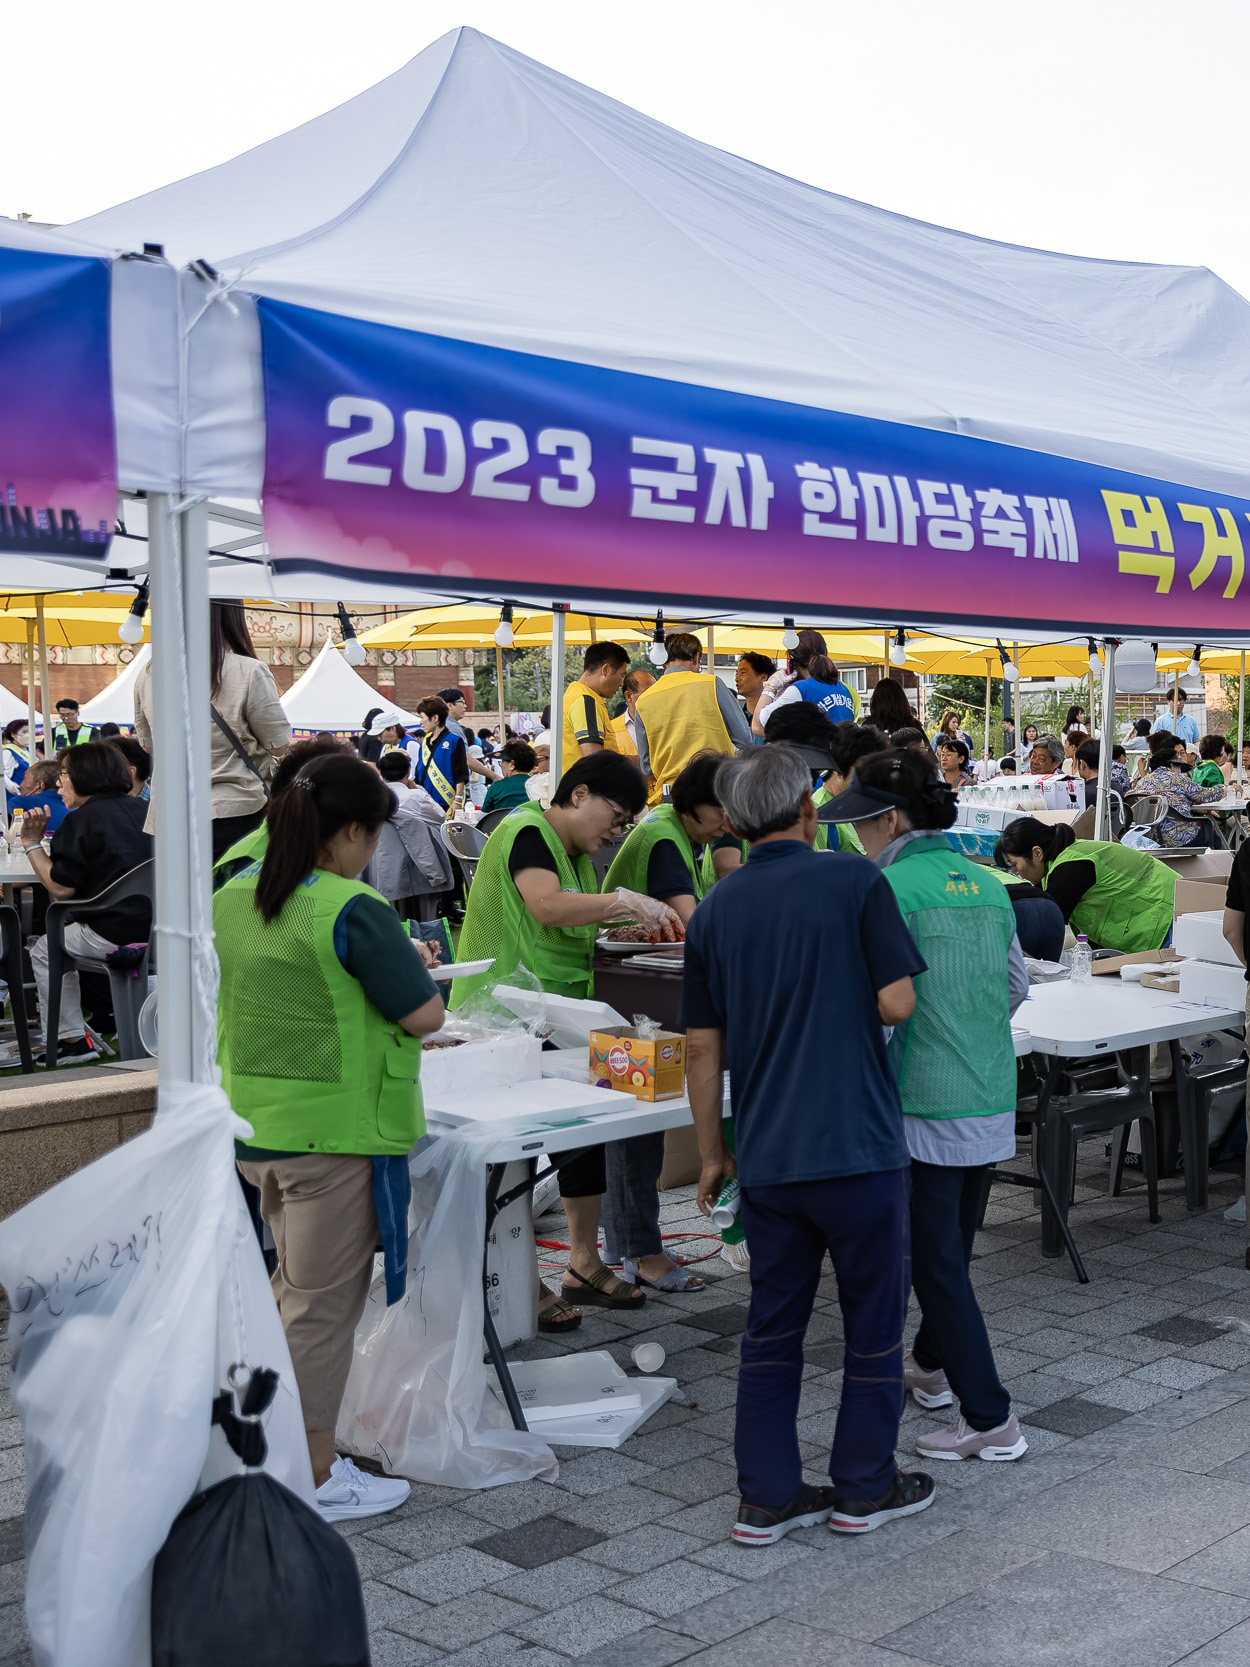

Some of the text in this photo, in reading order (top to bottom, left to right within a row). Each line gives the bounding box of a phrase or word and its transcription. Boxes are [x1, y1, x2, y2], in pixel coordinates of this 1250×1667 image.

[322, 395, 597, 509] 2023
[629, 436, 775, 531] 군자
[794, 460, 1080, 564] 한마당축제
[945, 881, 980, 896] 새마을
